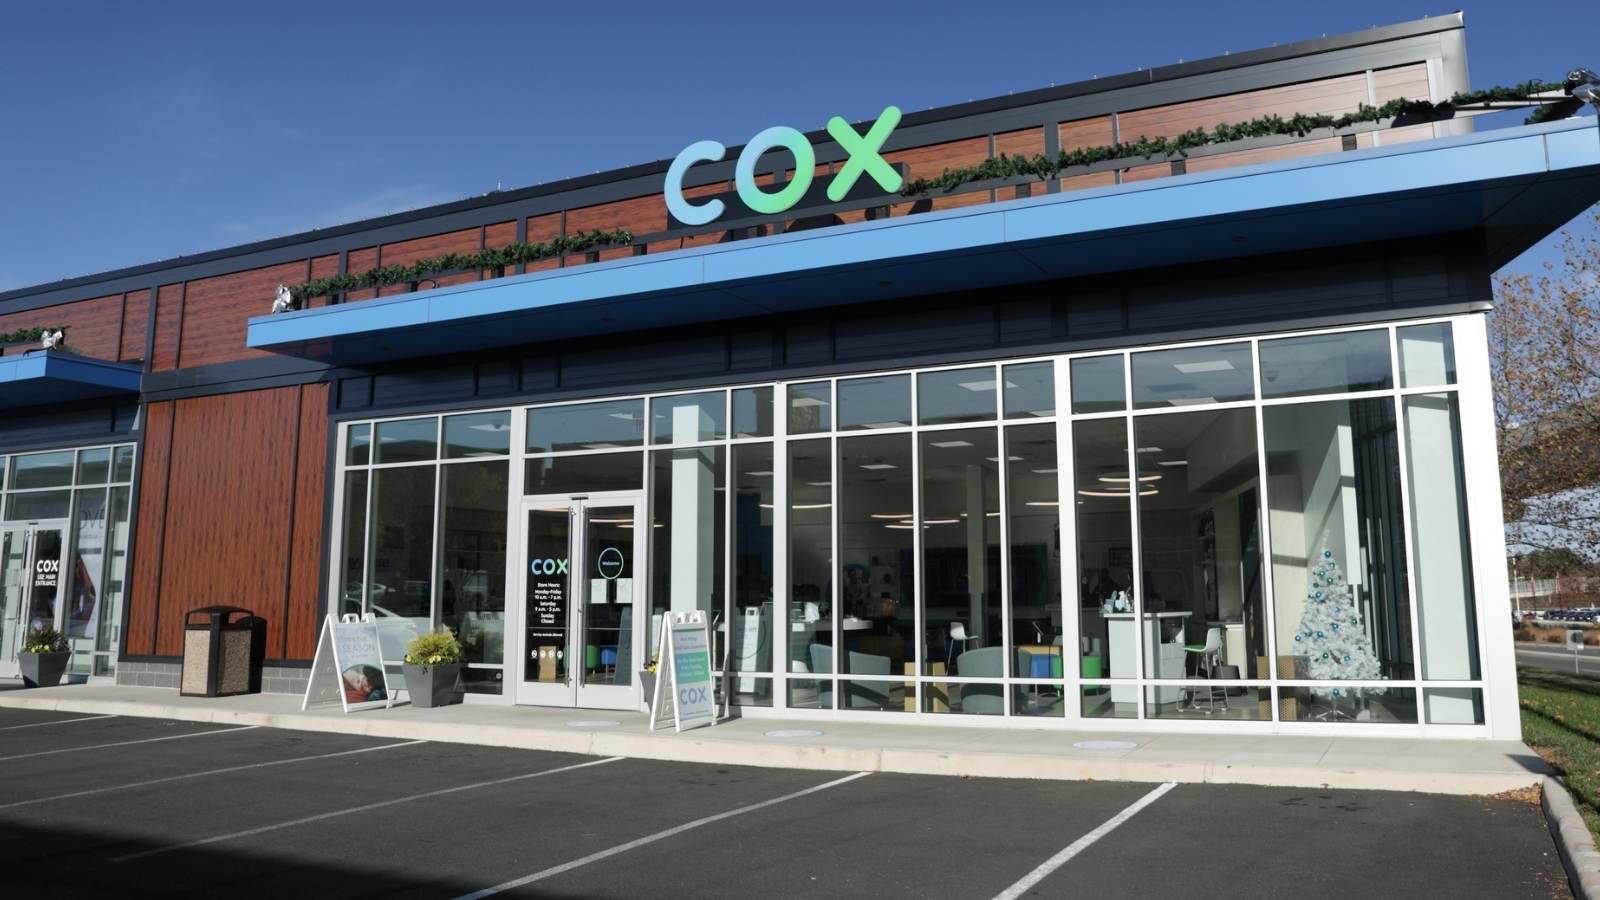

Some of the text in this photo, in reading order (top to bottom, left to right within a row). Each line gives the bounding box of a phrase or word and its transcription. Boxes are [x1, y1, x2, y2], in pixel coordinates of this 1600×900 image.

[664, 105, 903, 226] COX
[37, 560, 59, 573] COX
[531, 558, 568, 575] COX
[680, 687, 706, 705] COX
